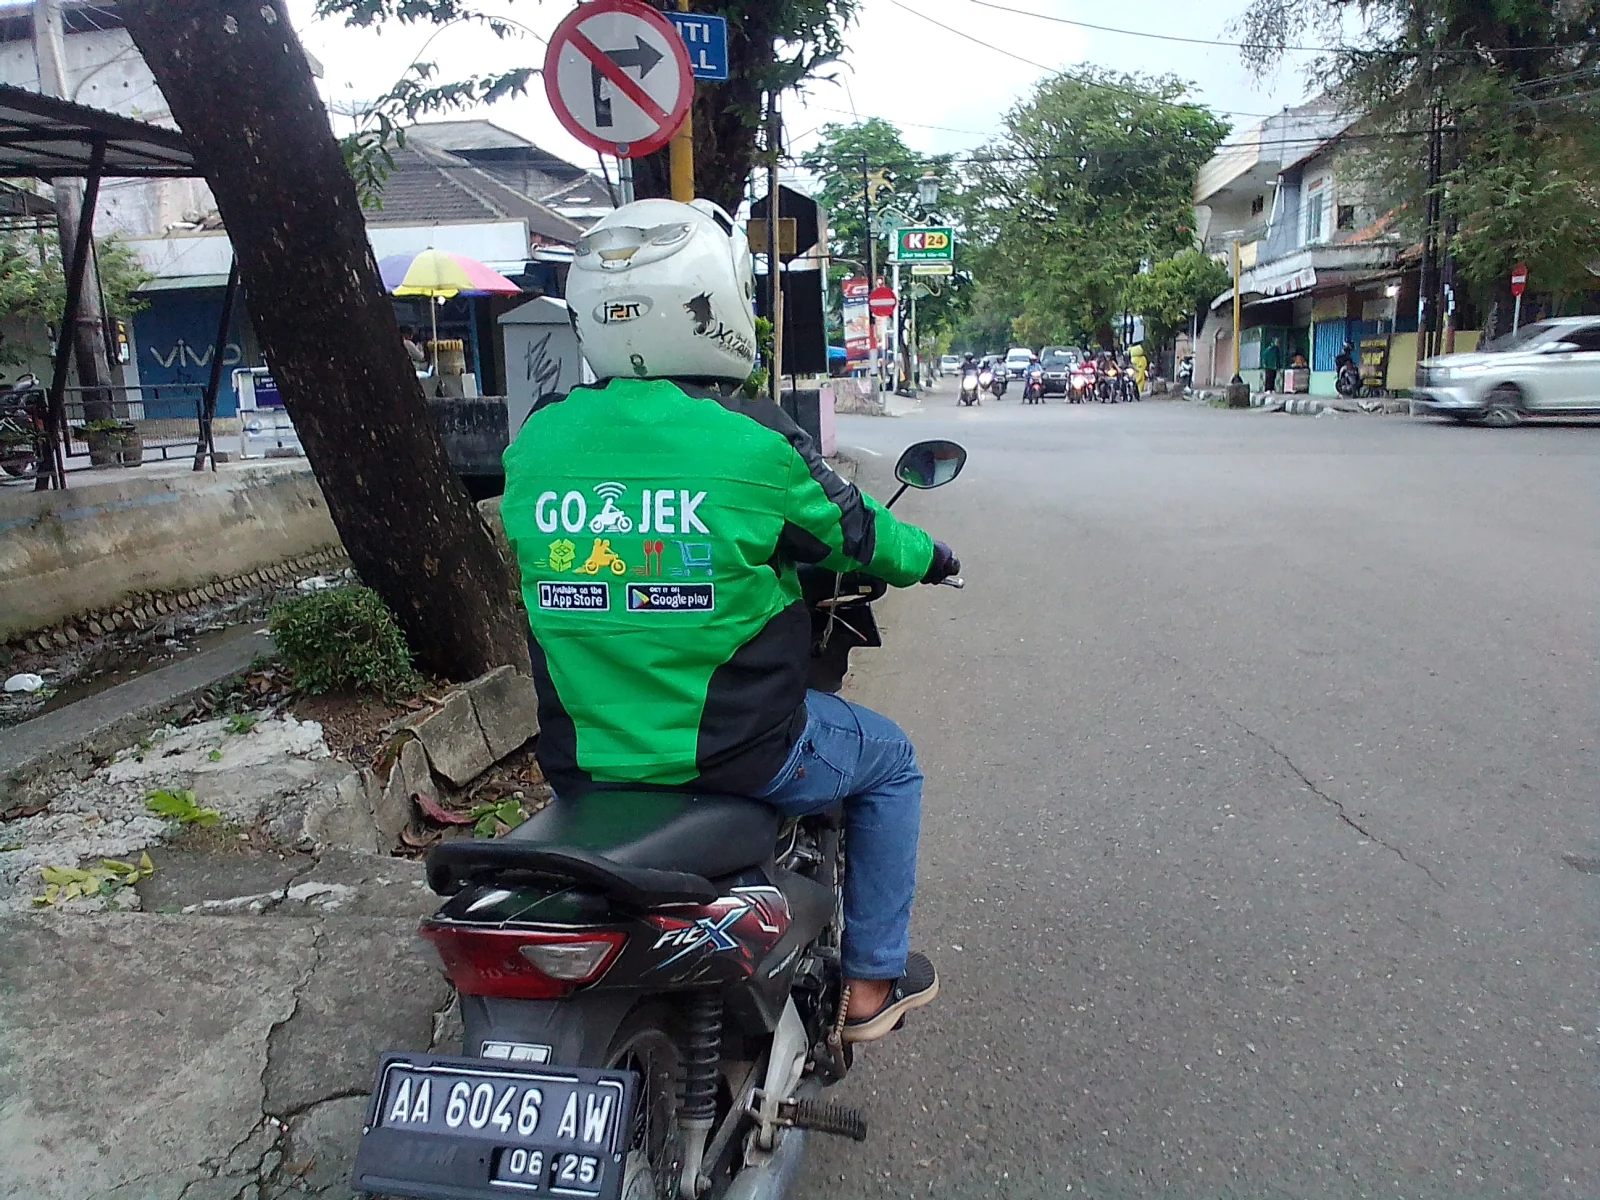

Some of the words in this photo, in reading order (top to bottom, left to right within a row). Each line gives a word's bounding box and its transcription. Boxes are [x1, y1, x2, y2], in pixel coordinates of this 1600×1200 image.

[927, 235, 944, 246] 24
[536, 490, 587, 534] GO
[638, 489, 710, 534] JEK
[552, 593, 572, 607] App
[573, 593, 603, 606] Store
[650, 593, 687, 608] Google
[688, 592, 709, 607] play
[390, 1077, 432, 1124] AA
[445, 1081, 542, 1136] 6046
[557, 1091, 612, 1143] AW
[509, 1149, 544, 1176] 06
[560, 1153, 598, 1183] 25
